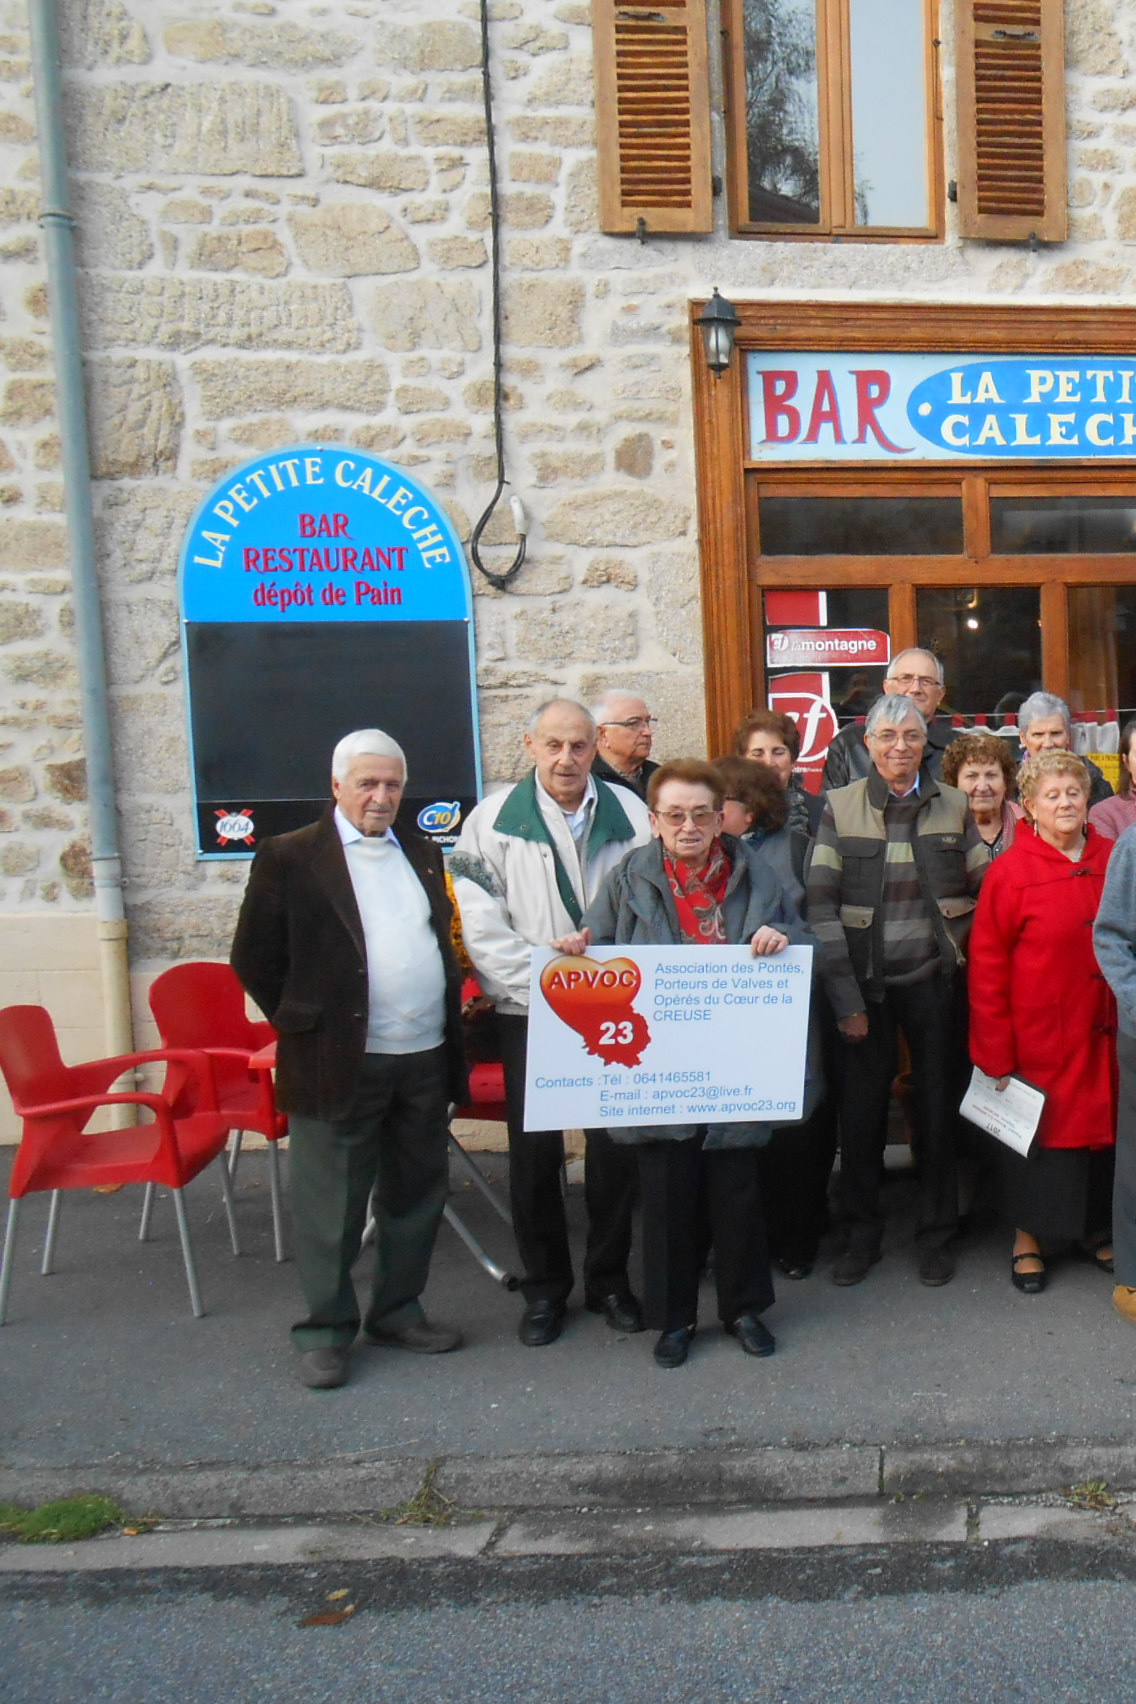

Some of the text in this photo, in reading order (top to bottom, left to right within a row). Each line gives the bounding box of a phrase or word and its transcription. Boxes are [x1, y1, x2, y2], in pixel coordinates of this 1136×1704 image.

[947, 371, 1003, 404] LA
[756, 369, 916, 454] BAR
[193, 457, 451, 569] LA PETITE CALECHE
[298, 512, 356, 540] BAR
[243, 546, 408, 574] RESTAURANT
[253, 580, 402, 612] dépôt de Pain
[802, 639, 877, 654] montagne
[423, 810, 452, 826] C10
[655, 962, 727, 974] Association
[732, 962, 753, 974] des
[550, 969, 638, 990] APVOC
[654, 977, 788, 989] Porteurs de Valves et
[704, 993, 719, 1005] du
[763, 993, 778, 1004] de
[782, 993, 793, 1004] la
[653, 1009, 711, 1021] CREUSE
[599, 1021, 634, 1045] 23
[535, 1076, 594, 1089] Contacts
[633, 1072, 711, 1085] 0641465581
[600, 1089, 641, 1102] E-mail
[652, 1085, 753, 1101] apvoc23@live.fr
[600, 1105, 624, 1117] Site
[628, 1103, 676, 1116] internet
[687, 1099, 797, 1115] www.apvoc23.org
